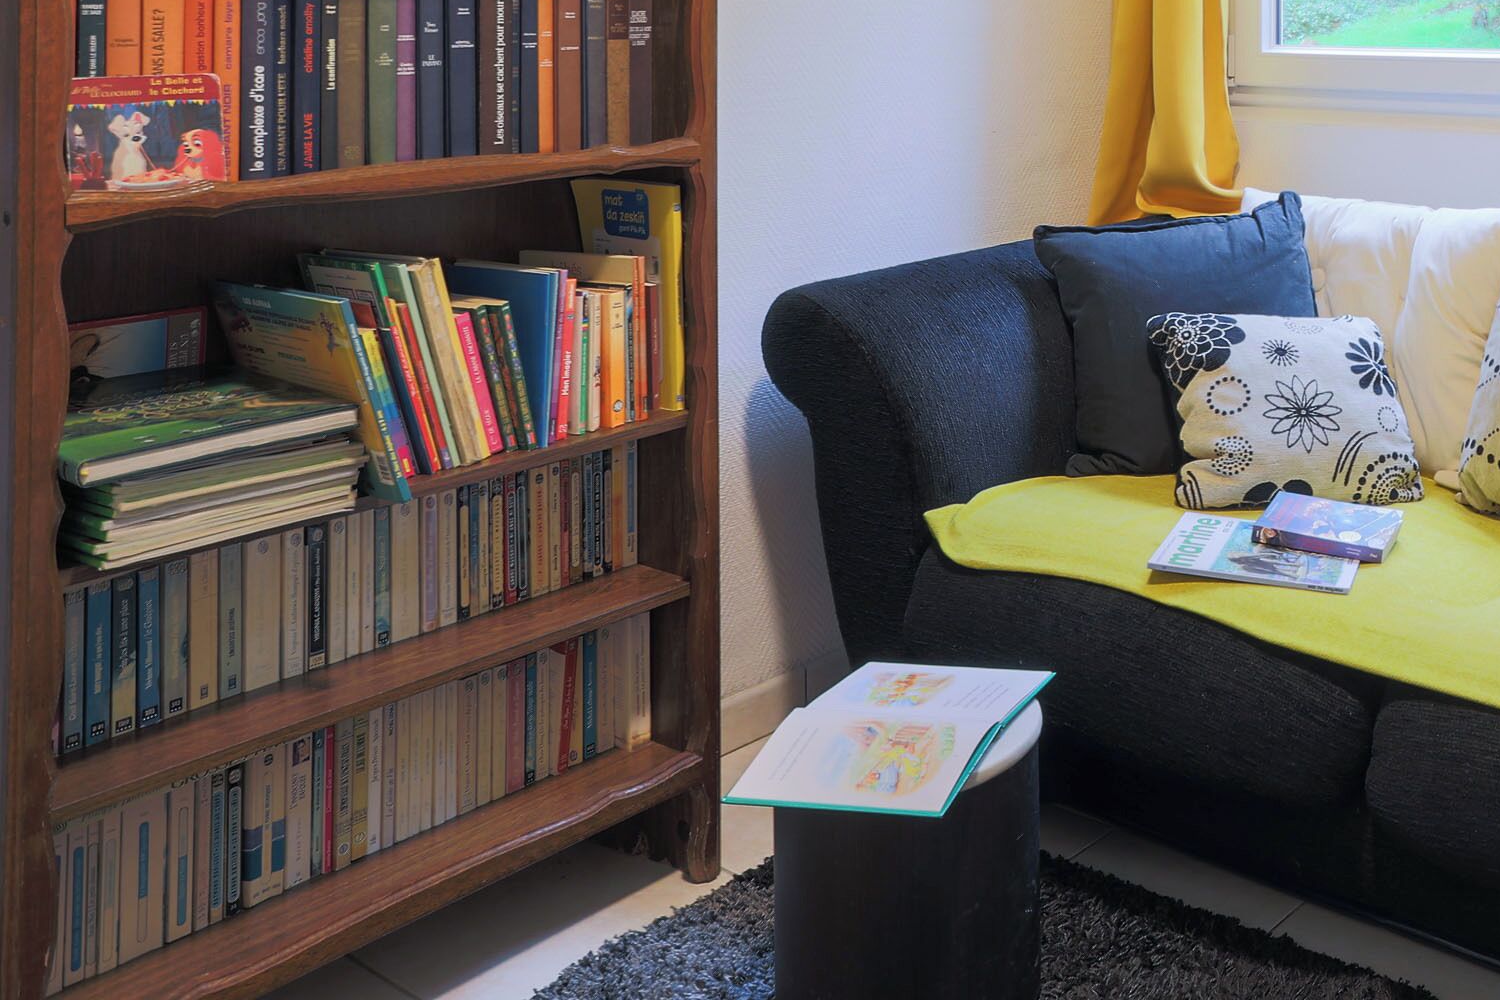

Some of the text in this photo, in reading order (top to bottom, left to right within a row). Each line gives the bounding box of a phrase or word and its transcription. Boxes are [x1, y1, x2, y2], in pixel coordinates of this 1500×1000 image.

[496, 25, 506, 46] pour
[151, 53, 165, 76] ANS
[303, 37, 313, 73] christine
[494, 46, 505, 81] cachent
[151, 78, 161, 86] La
[166, 77, 189, 85] Belle
[162, 87, 204, 95] Clochard
[495, 82, 505, 91] se
[223, 84, 232, 114] NOIR
[277, 97, 286, 123] POUR
[494, 94, 505, 129] oiseaux
[249, 65, 268, 172] le complexe d'Icare
[277, 125, 286, 161] AMANT
[303, 113, 313, 169] J'AIME LA VIE
[494, 129, 505, 145] Les
[1168, 517, 1222, 567] martine
